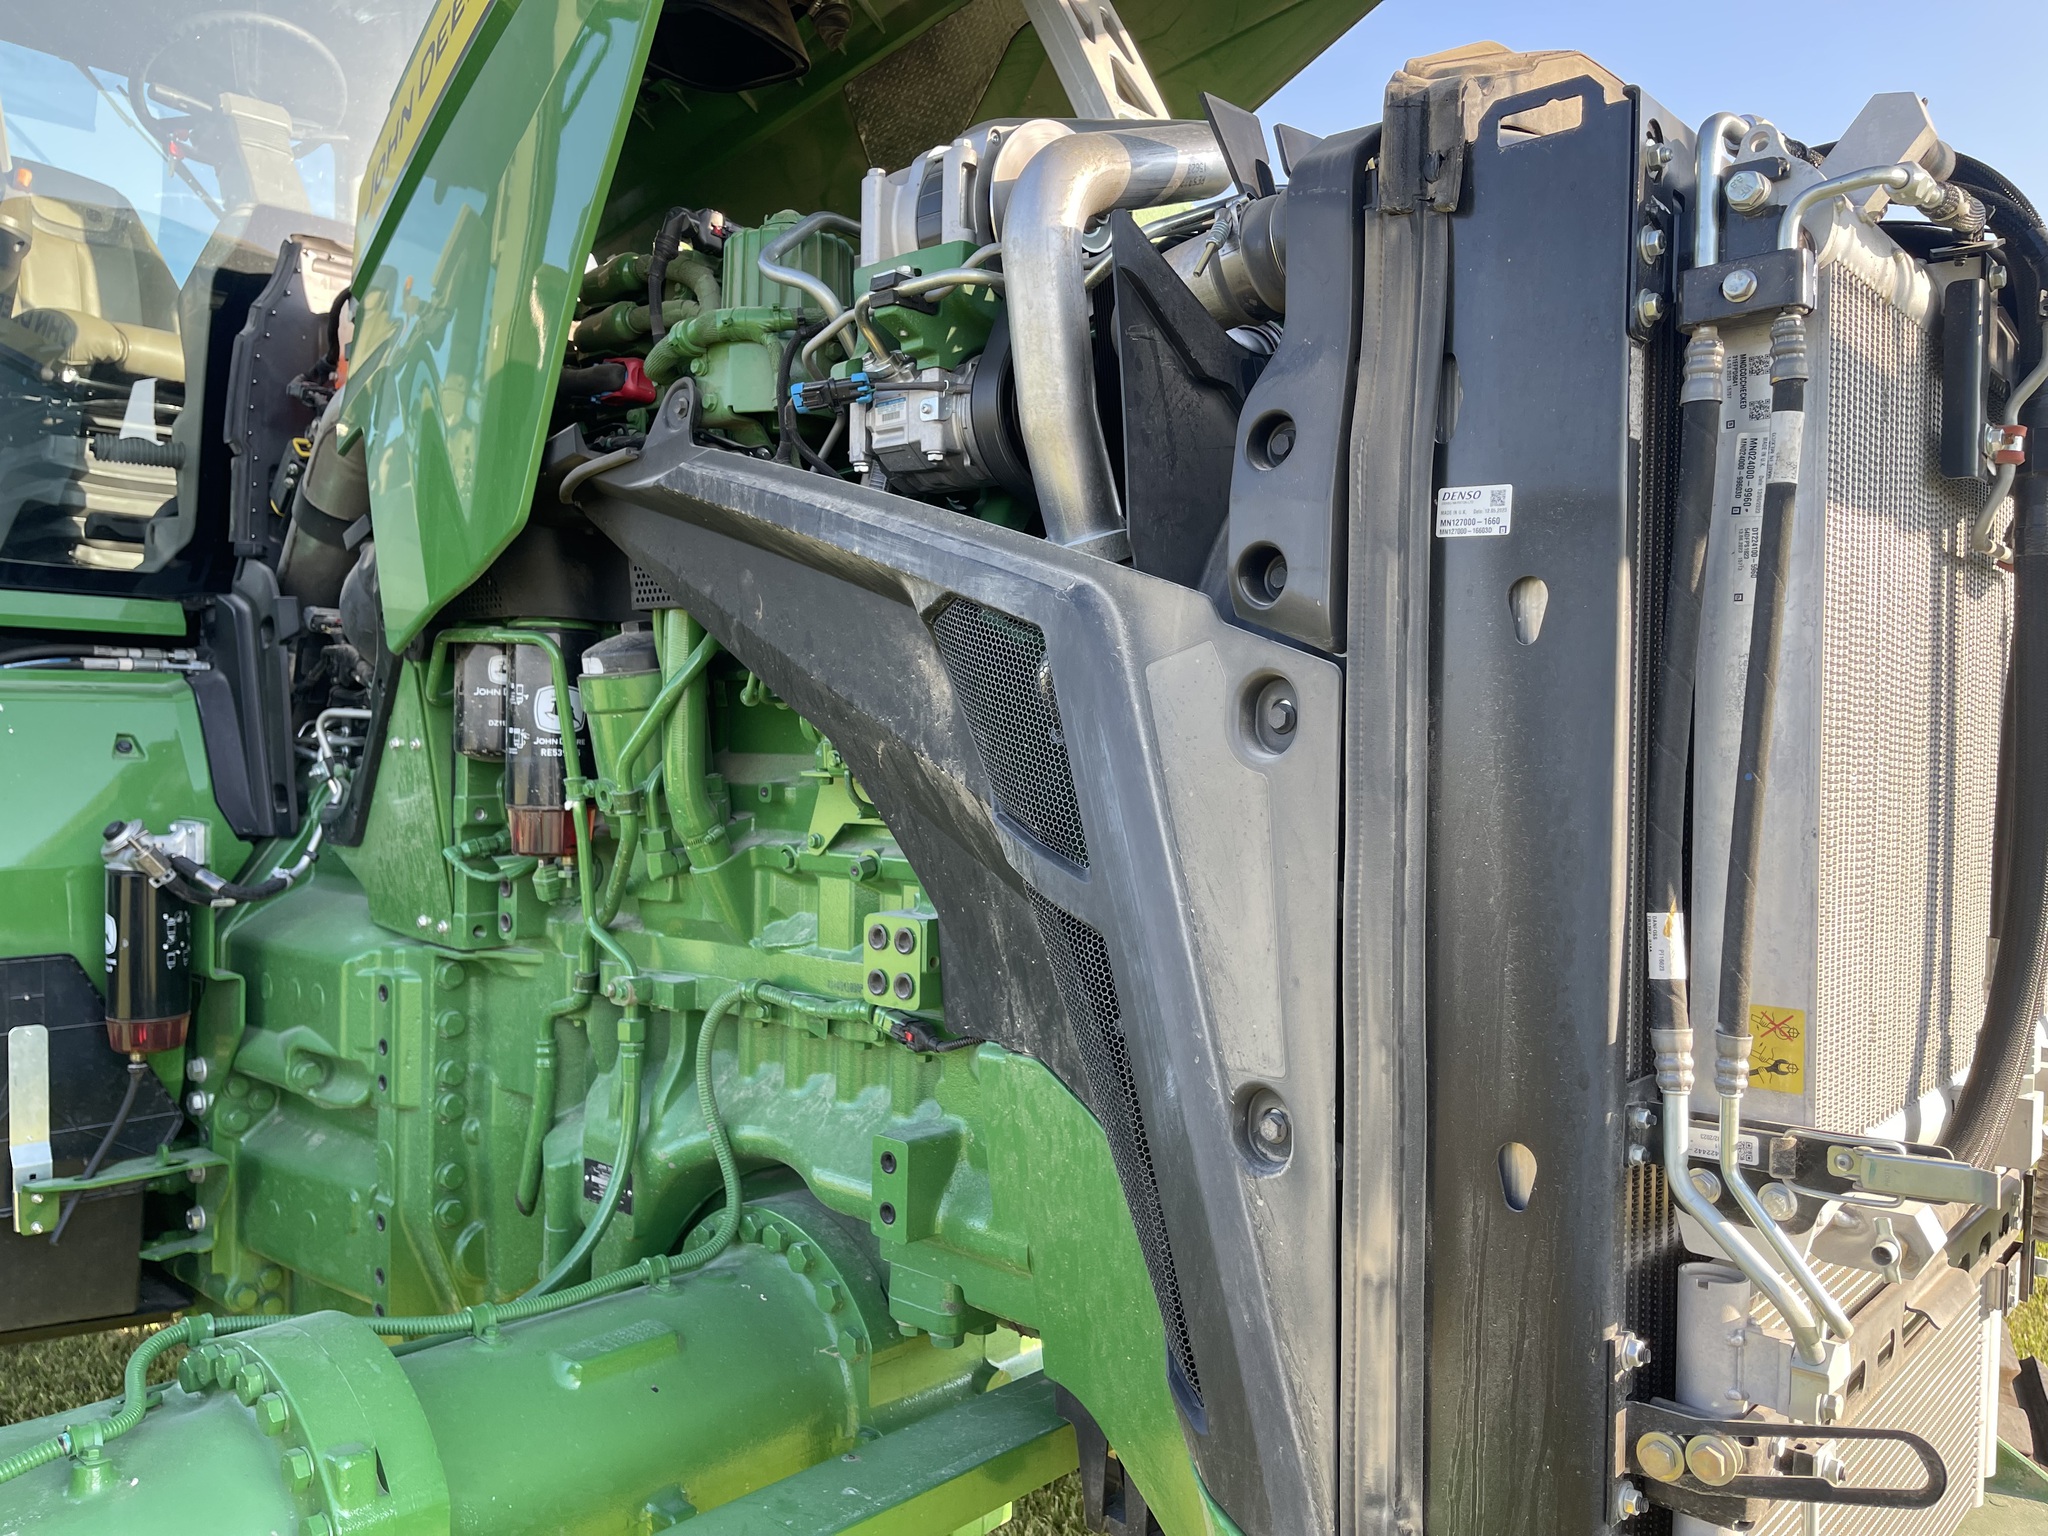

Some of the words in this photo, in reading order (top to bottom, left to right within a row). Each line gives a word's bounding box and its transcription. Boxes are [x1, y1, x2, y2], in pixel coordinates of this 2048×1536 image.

[365, 86, 414, 221] JOHN
[418, 0, 470, 102] DEE
[1442, 490, 1482, 501] DENSO
[473, 687, 501, 696] JOHN
[533, 736, 559, 745] JOHN
